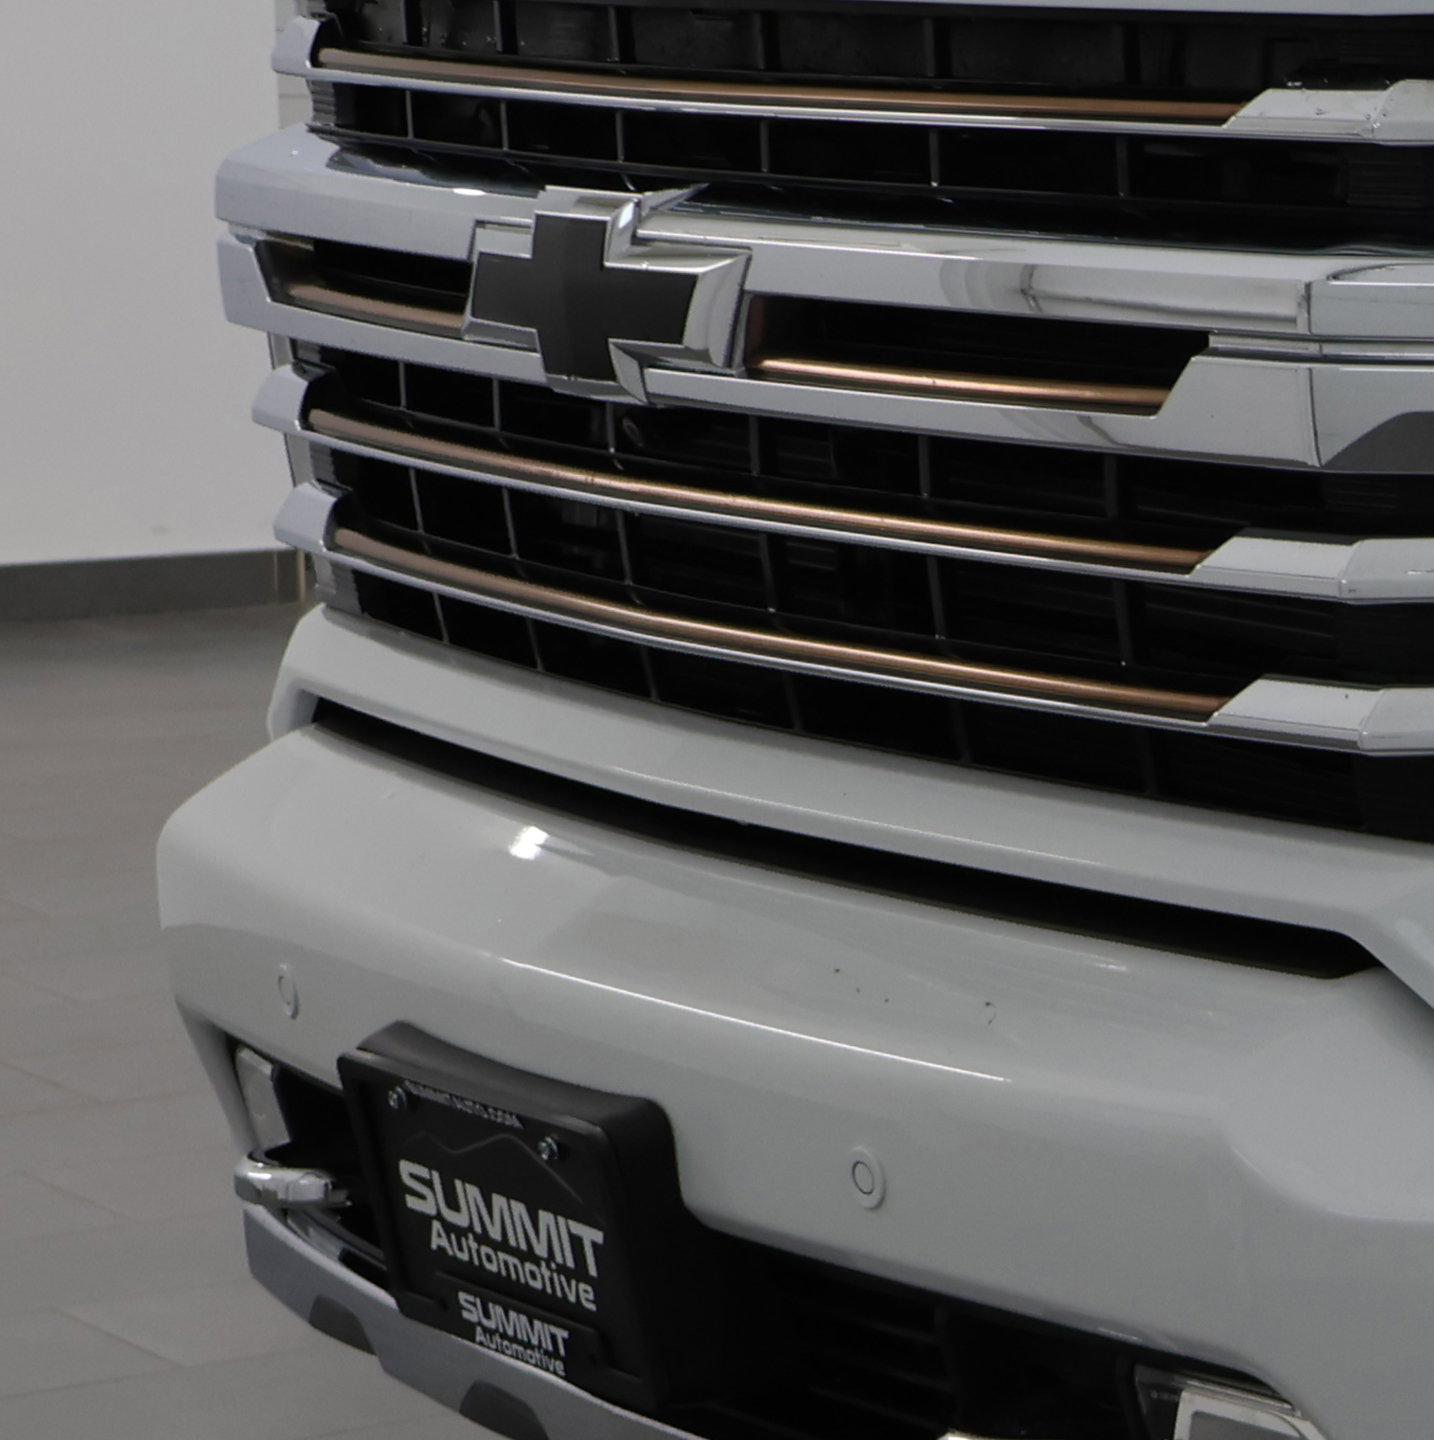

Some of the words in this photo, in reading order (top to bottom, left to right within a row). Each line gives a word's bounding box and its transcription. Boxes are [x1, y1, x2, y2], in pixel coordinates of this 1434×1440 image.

[399, 1159, 604, 1278] SUMMIT
[431, 1220, 597, 1312] Automotive
[458, 1291, 570, 1357] SUMMIT
[475, 1326, 566, 1377] Automotive
